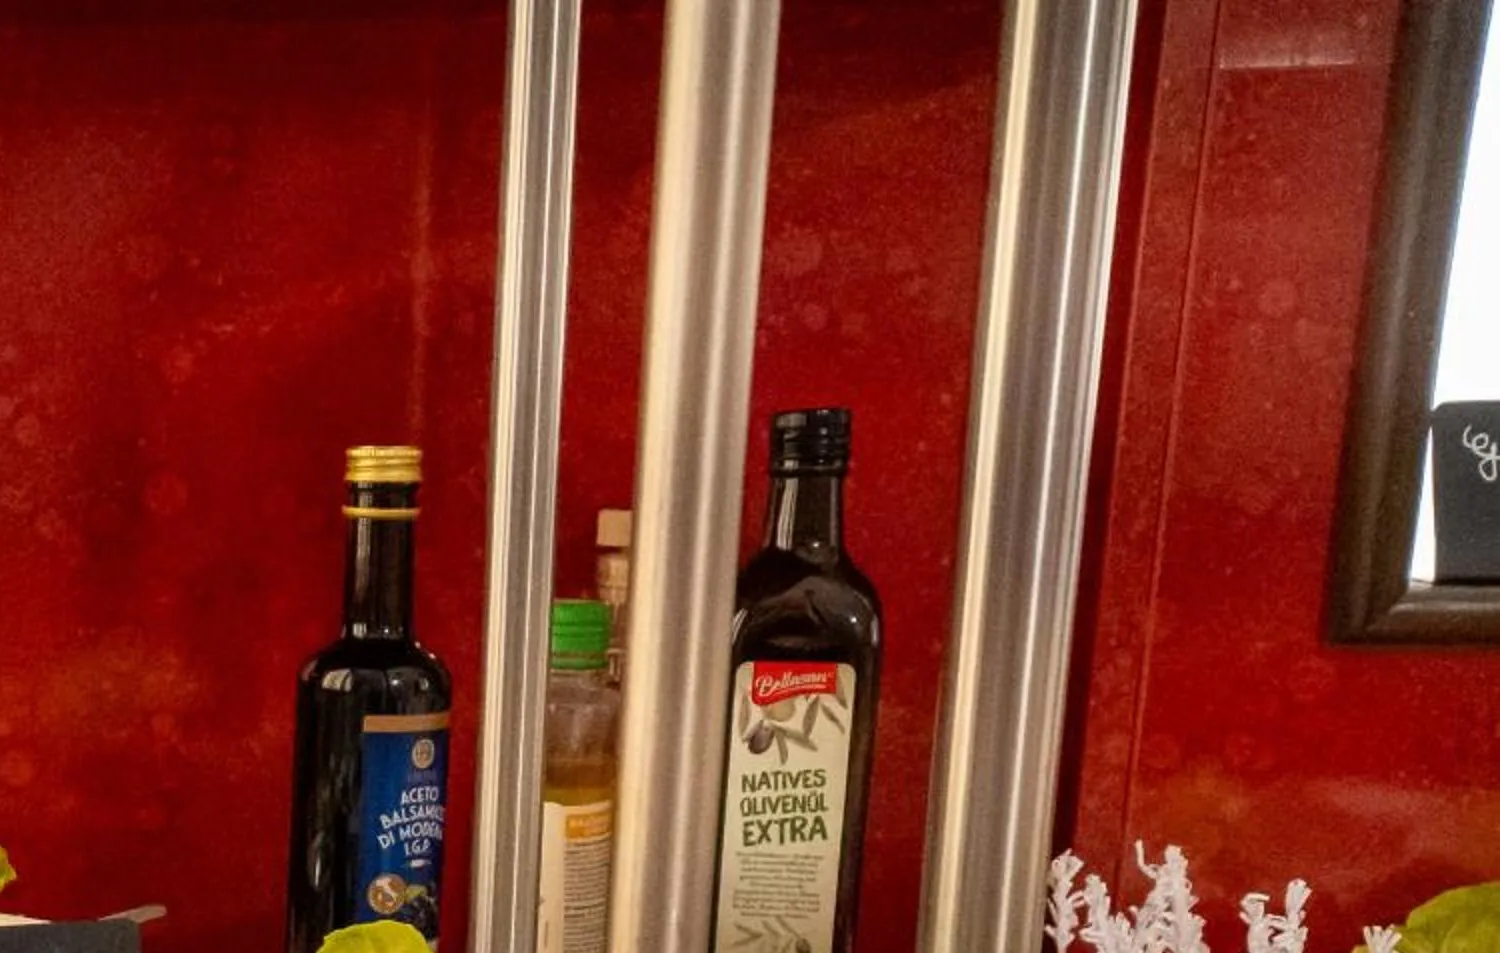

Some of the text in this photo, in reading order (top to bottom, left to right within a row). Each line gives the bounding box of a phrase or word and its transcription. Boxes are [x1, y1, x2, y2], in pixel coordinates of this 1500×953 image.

[741, 769, 827, 793] NATIVES
[400, 786, 439, 806] ACETO
[740, 792, 829, 817] OLIVENÖL
[377, 821, 443, 849] DI MODEN
[742, 816, 828, 847] EXTRA
